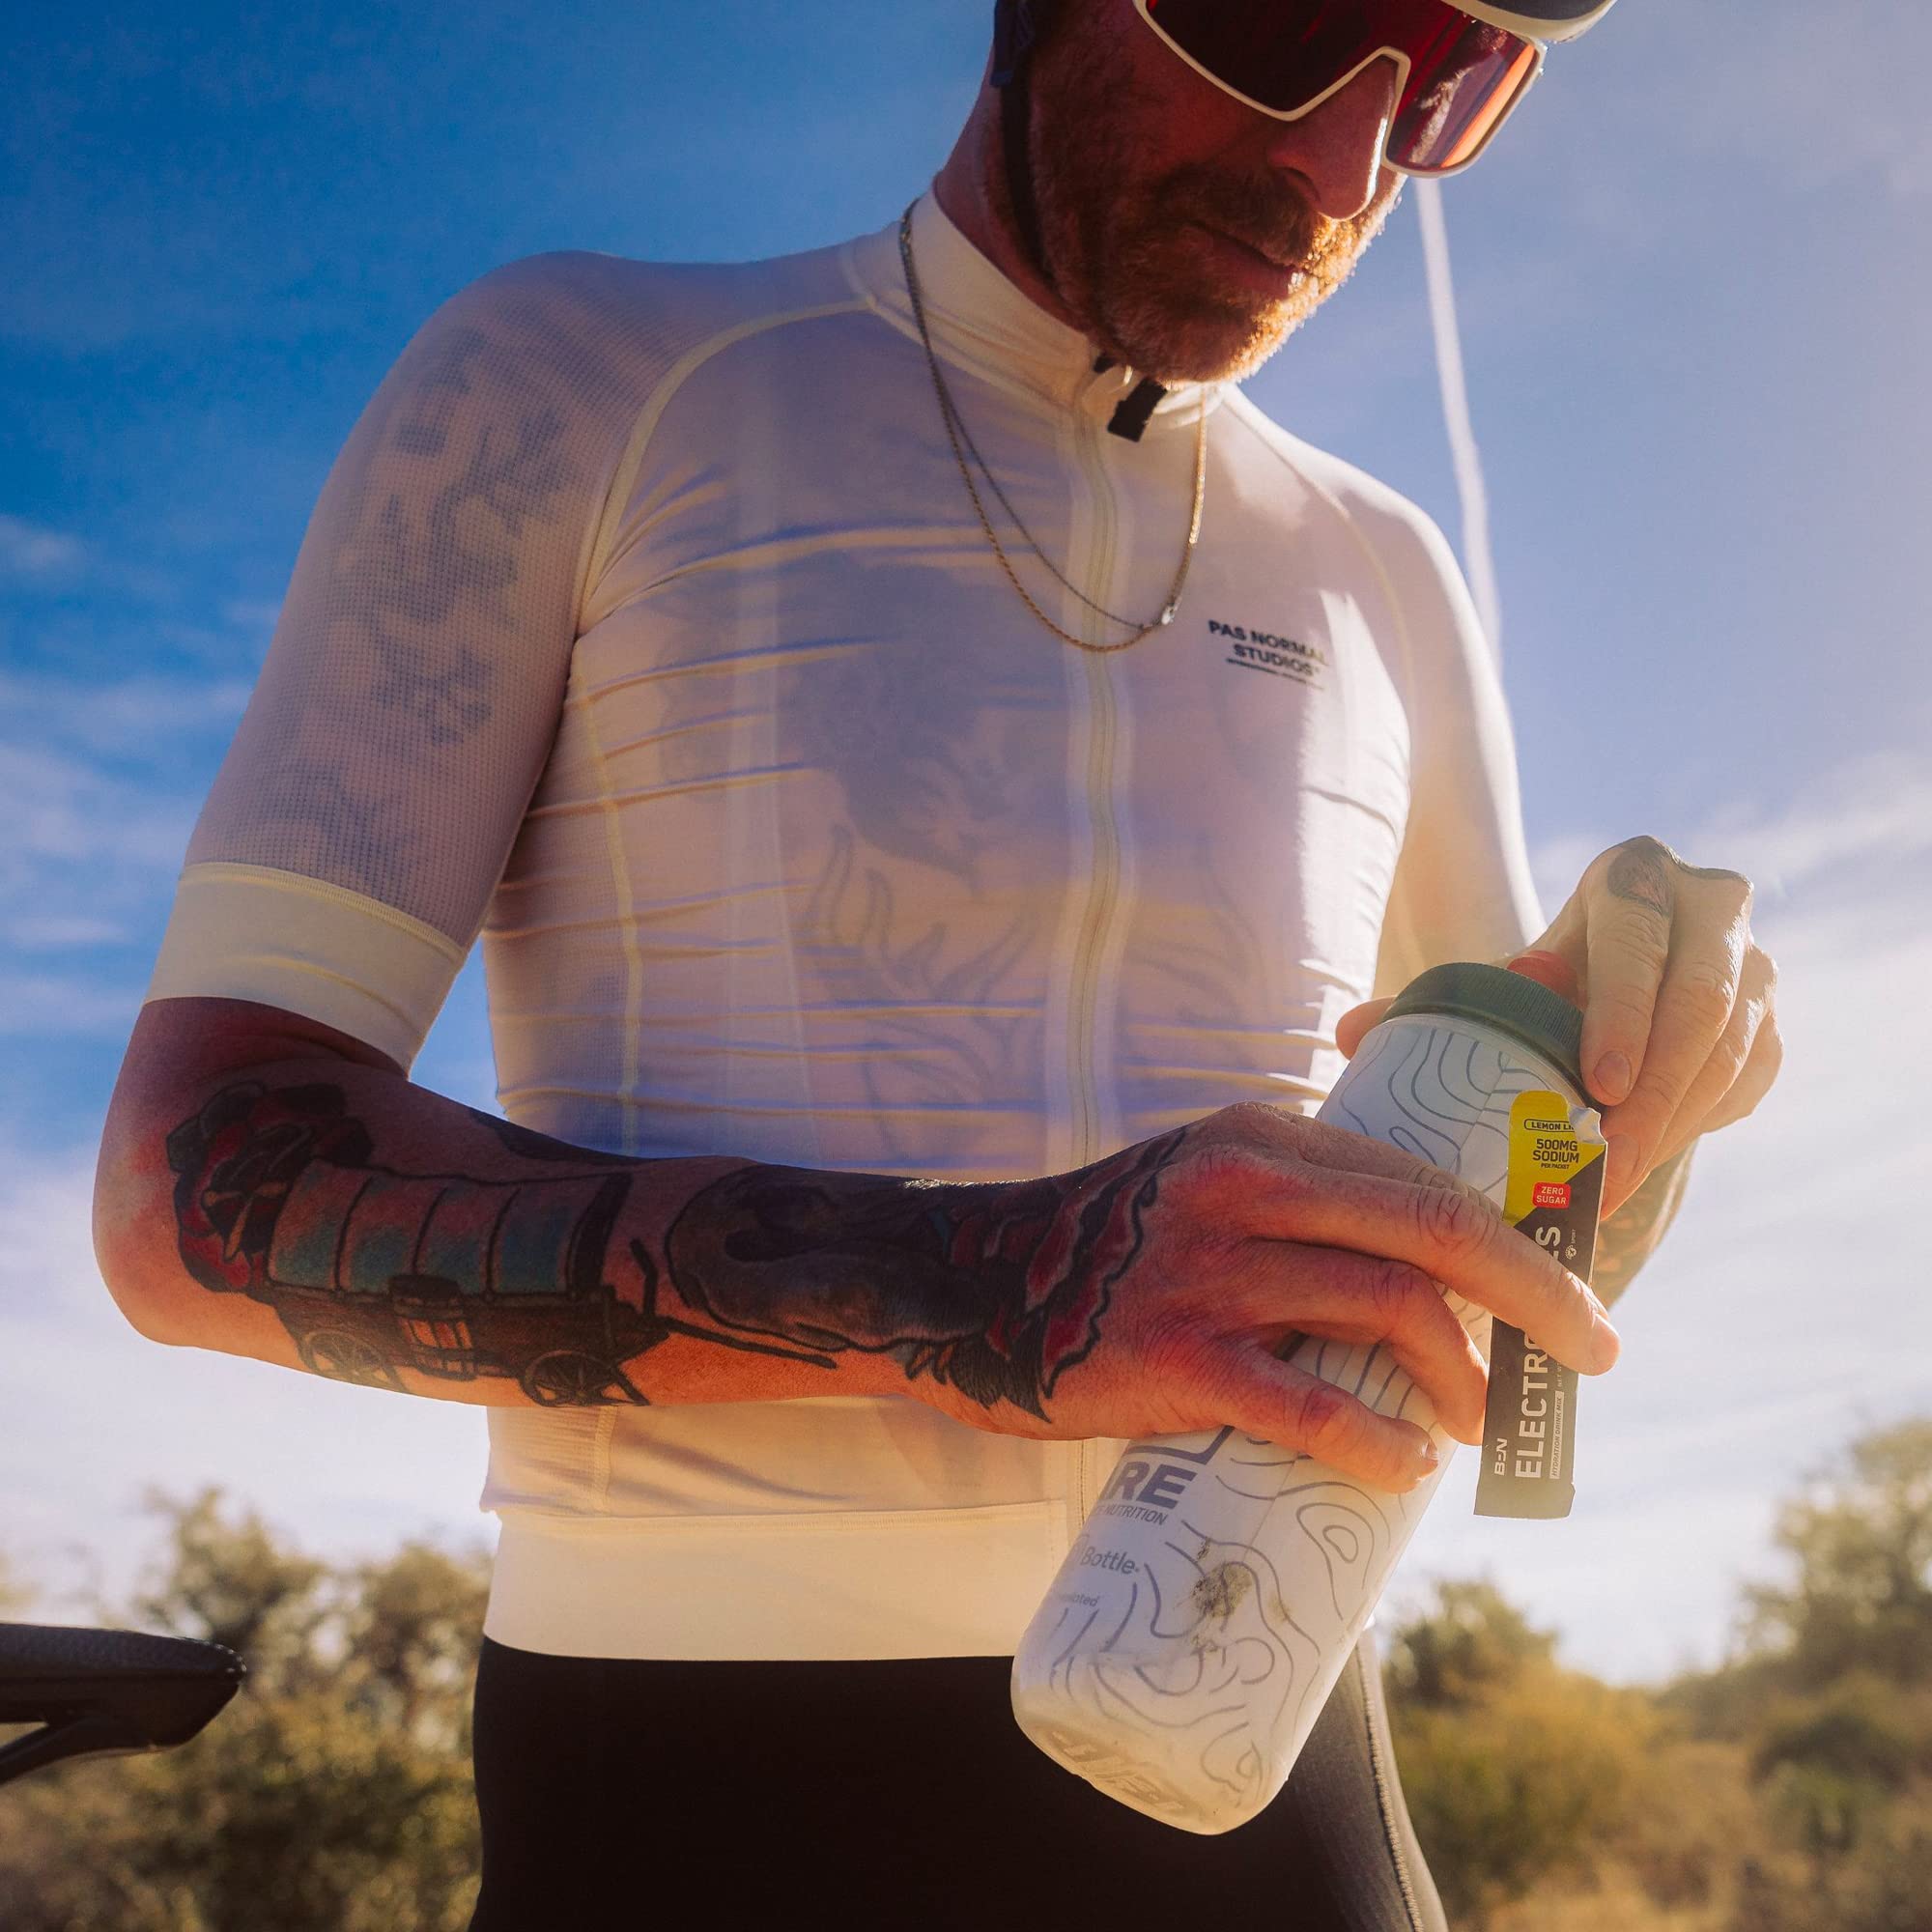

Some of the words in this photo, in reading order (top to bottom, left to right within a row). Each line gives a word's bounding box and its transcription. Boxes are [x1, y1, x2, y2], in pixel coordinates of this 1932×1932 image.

[1208, 619, 1246, 640] PAS
[1531, 1122, 1561, 1130] LEMON
[1536, 1138, 1578, 1151] 500MG
[1532, 1150, 1579, 1163] SODIUM
[1541, 1186, 1564, 1196] ZERO
[1536, 1195, 1567, 1205] SUGAR
[1551, 1435, 1561, 1477] HYDRATION
